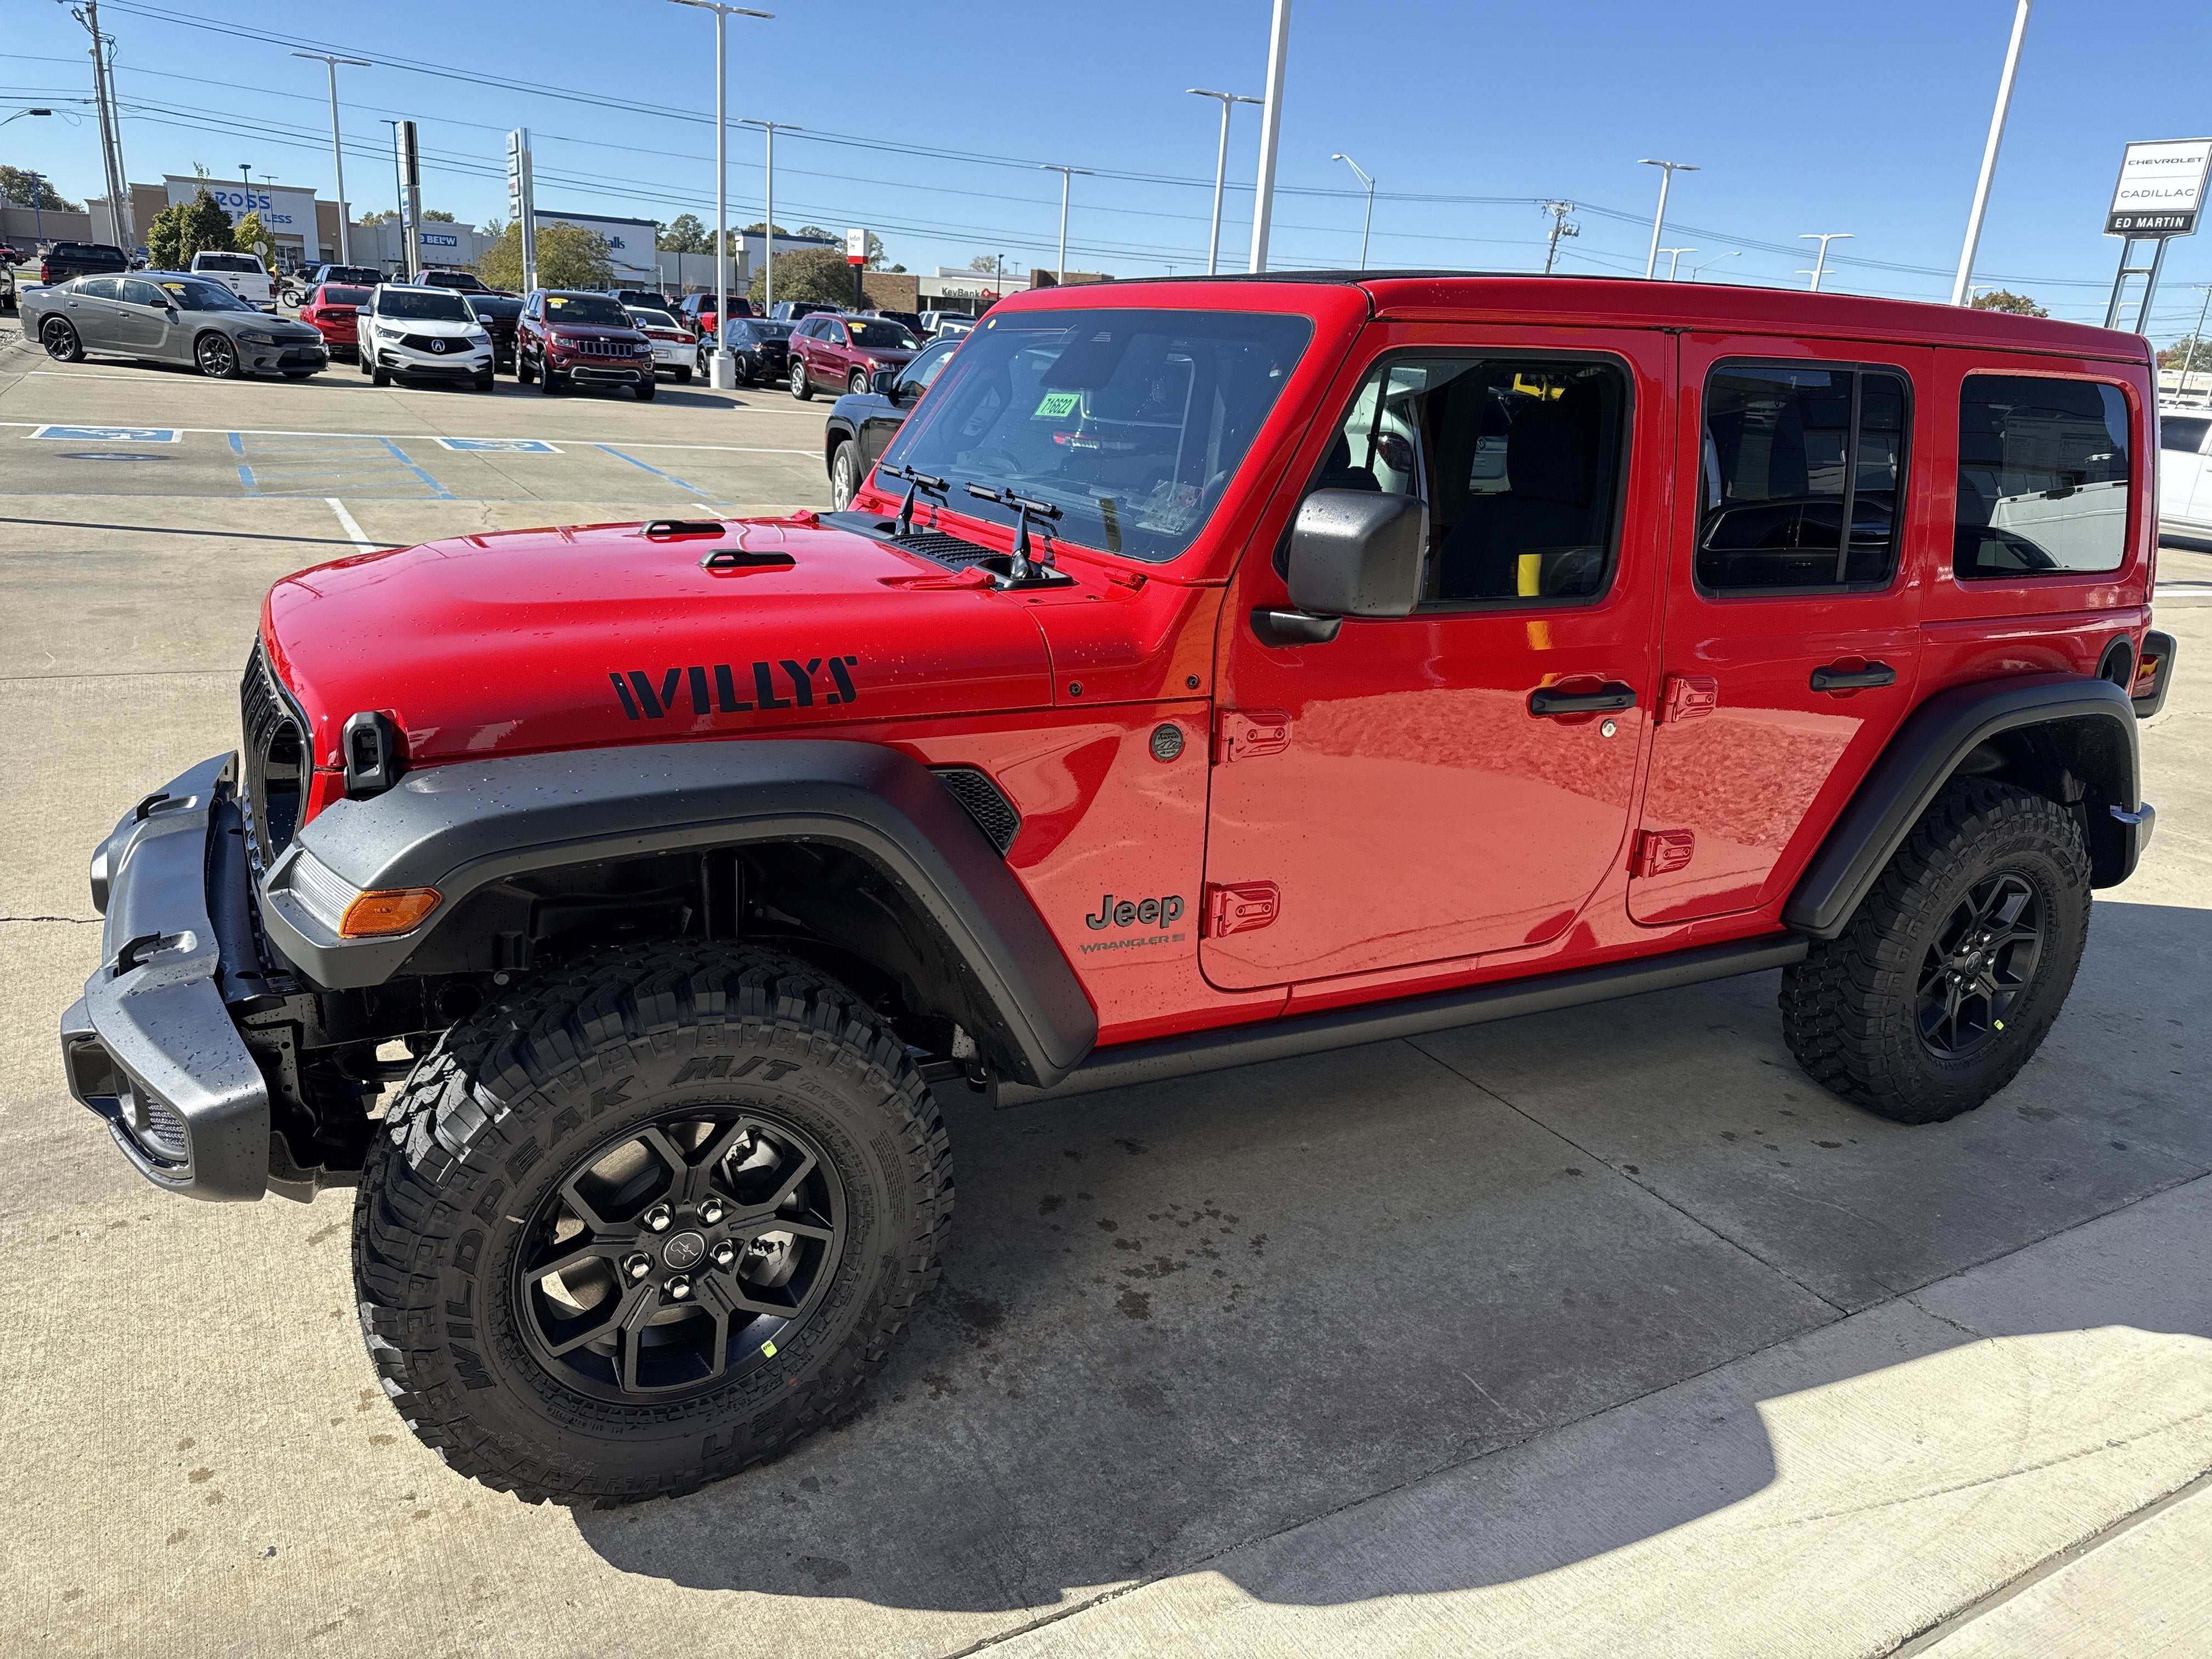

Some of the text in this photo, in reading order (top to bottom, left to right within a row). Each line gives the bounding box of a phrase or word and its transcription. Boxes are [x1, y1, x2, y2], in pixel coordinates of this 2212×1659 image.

[2128, 157, 2204, 165] CHEVROLET
[215, 191, 270, 209] ROSS
[2120, 189, 2195, 198] CADILLAC
[264, 213, 292, 224] LESS
[2115, 217, 2185, 228] ED MARTIN
[427, 235, 456, 246] BELOW
[941, 287, 980, 298] KeyBank
[1040, 398, 1073, 414] 716622
[608, 656, 858, 720] WILLYS
[1086, 894, 1184, 930] Jeep
[1080, 935, 1170, 953] WRANGLER
[445, 1075, 635, 1390] WILDPEAK
[668, 1056, 803, 1087] M/T
